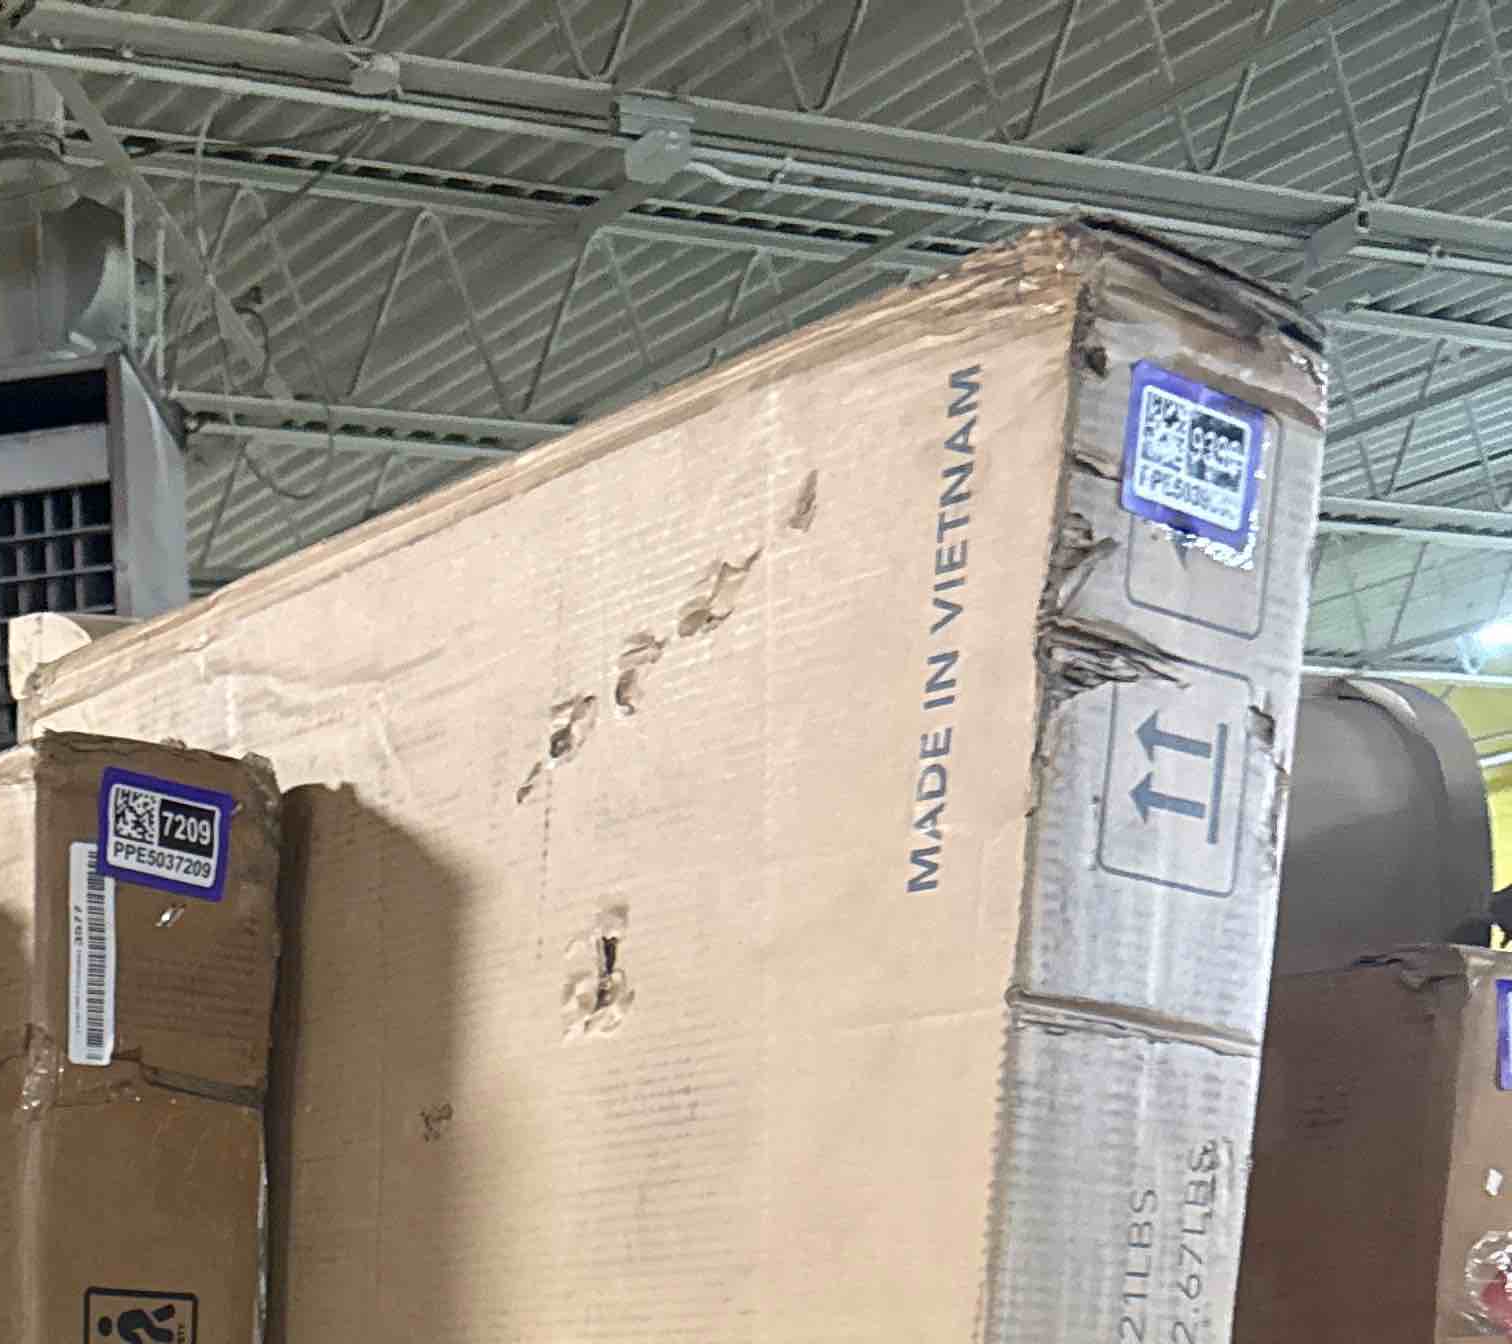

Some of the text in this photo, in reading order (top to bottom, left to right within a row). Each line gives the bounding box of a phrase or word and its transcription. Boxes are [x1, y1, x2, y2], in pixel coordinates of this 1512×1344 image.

[906, 363, 983, 893] MADE IN VIETNAM
[161, 812, 212, 845] 7209
[112, 841, 211, 879] PPE5037209
